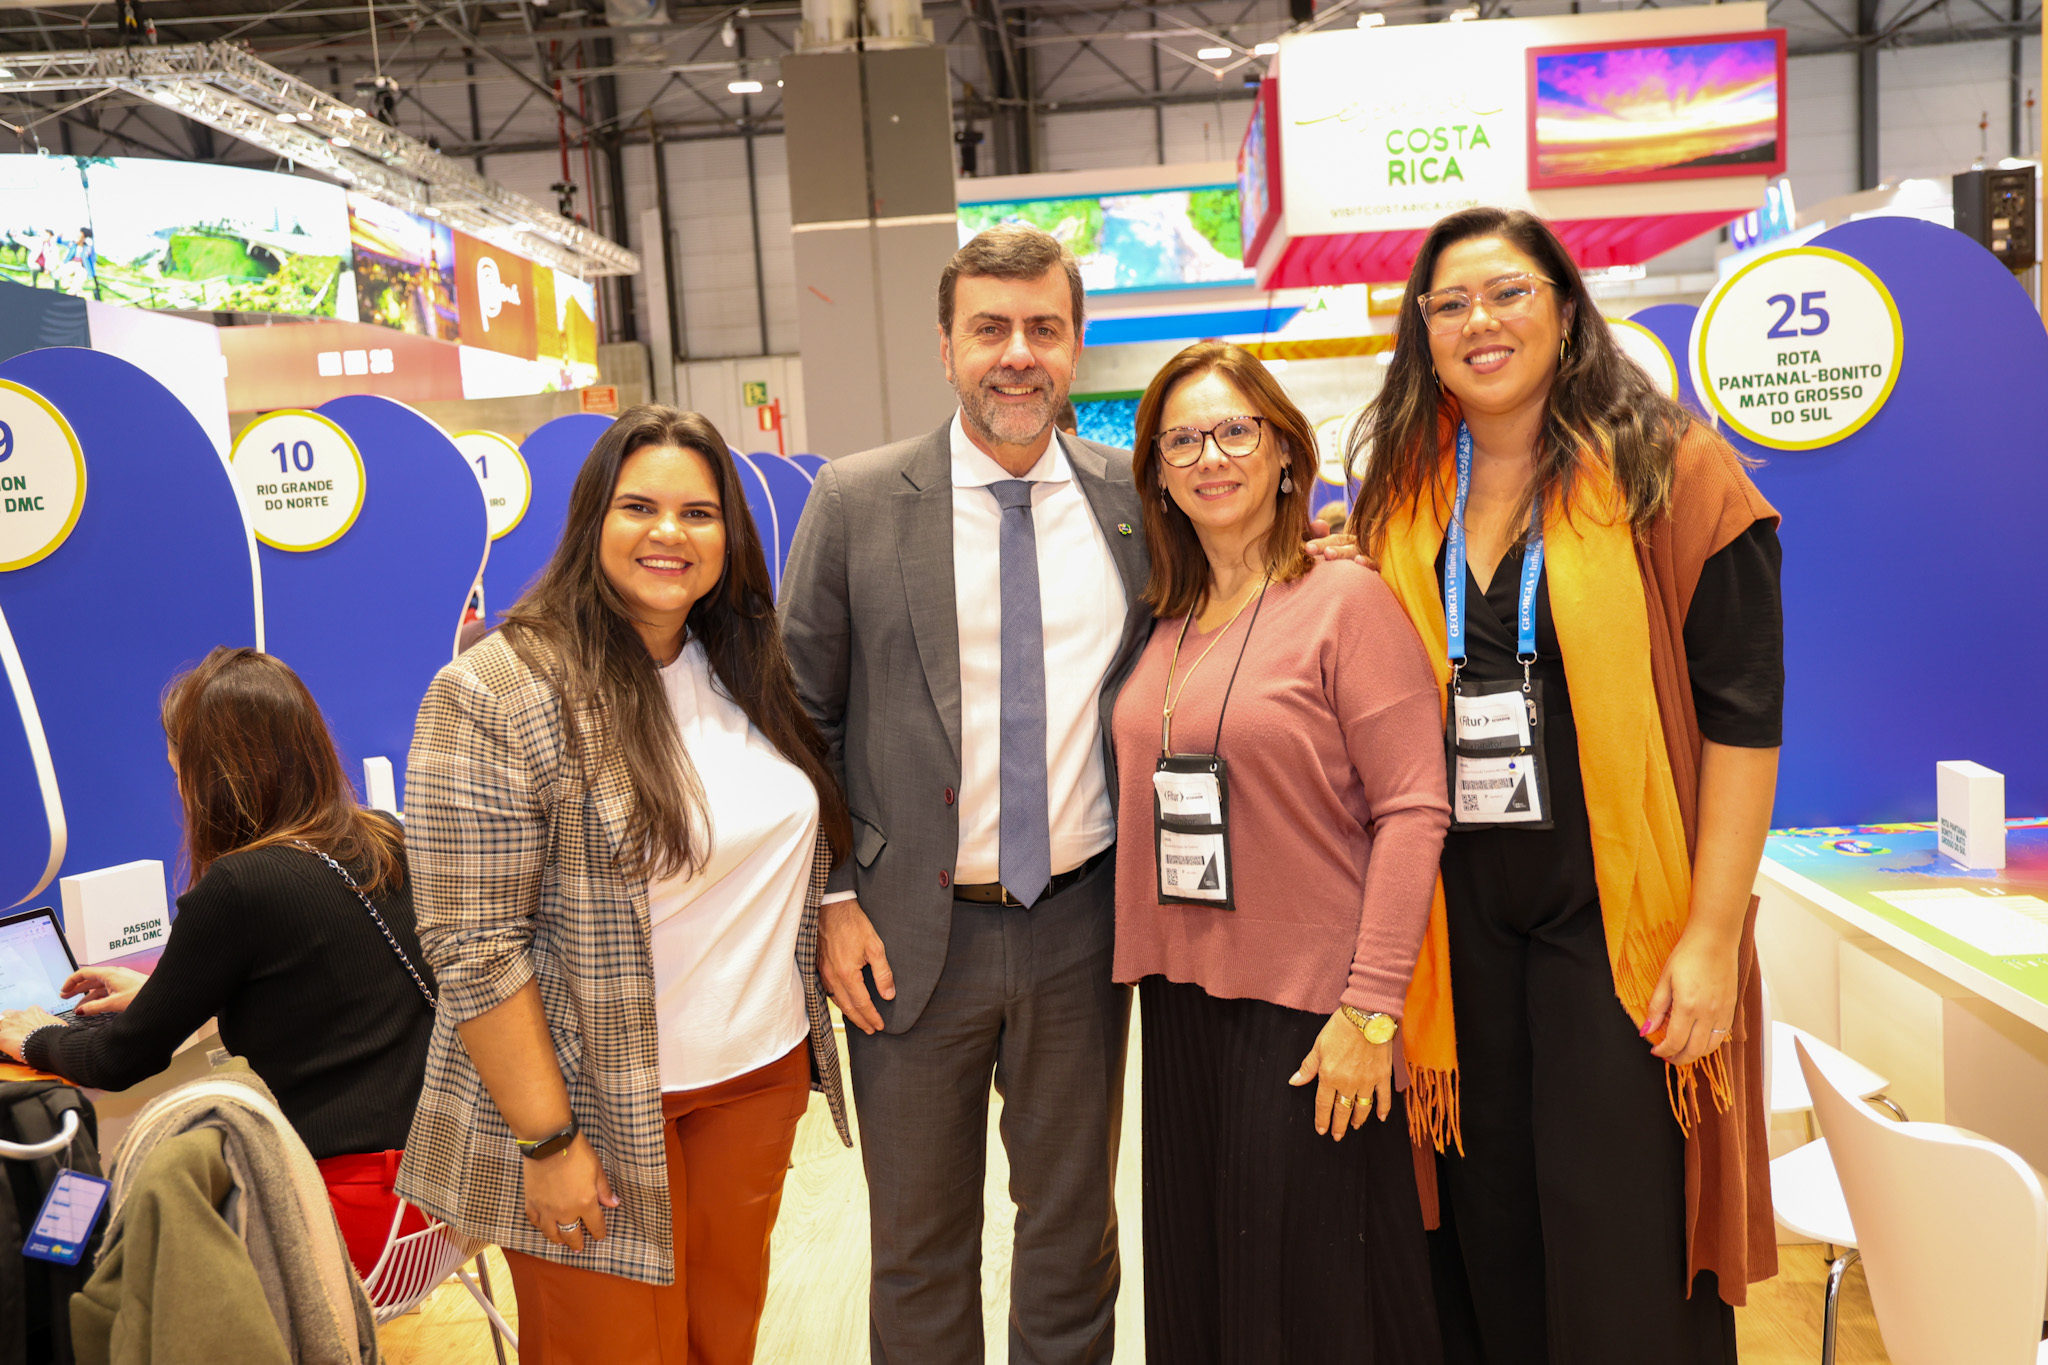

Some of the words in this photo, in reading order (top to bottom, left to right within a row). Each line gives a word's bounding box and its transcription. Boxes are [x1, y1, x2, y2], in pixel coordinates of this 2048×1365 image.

[1386, 123, 1491, 155] COSTA
[1388, 155, 1464, 186] RICA
[1766, 290, 1830, 339] 25
[1777, 350, 1821, 366] ROTA
[1719, 364, 1882, 390] PANTANAL-BONITO
[1740, 391, 1789, 408] MATO
[1794, 385, 1863, 403] GROSSO
[1771, 410, 1795, 425] DO
[1800, 407, 1832, 422] SUL
[271, 440, 314, 473] 10
[475, 454, 488, 479] 1
[256, 483, 278, 495] RIO
[281, 480, 334, 493] GRANDE
[5, 496, 45, 513] DMC
[265, 499, 283, 511] DO
[286, 496, 329, 509] NORTE
[1447, 547, 1457, 579] Infinite
[1448, 586, 1459, 638] GEORGIA
[1521, 579, 1535, 631] GEORGIA
[109, 934, 141, 950] BRAZIL
[143, 928, 162, 941] DMC
[123, 918, 161, 935] PASSION
